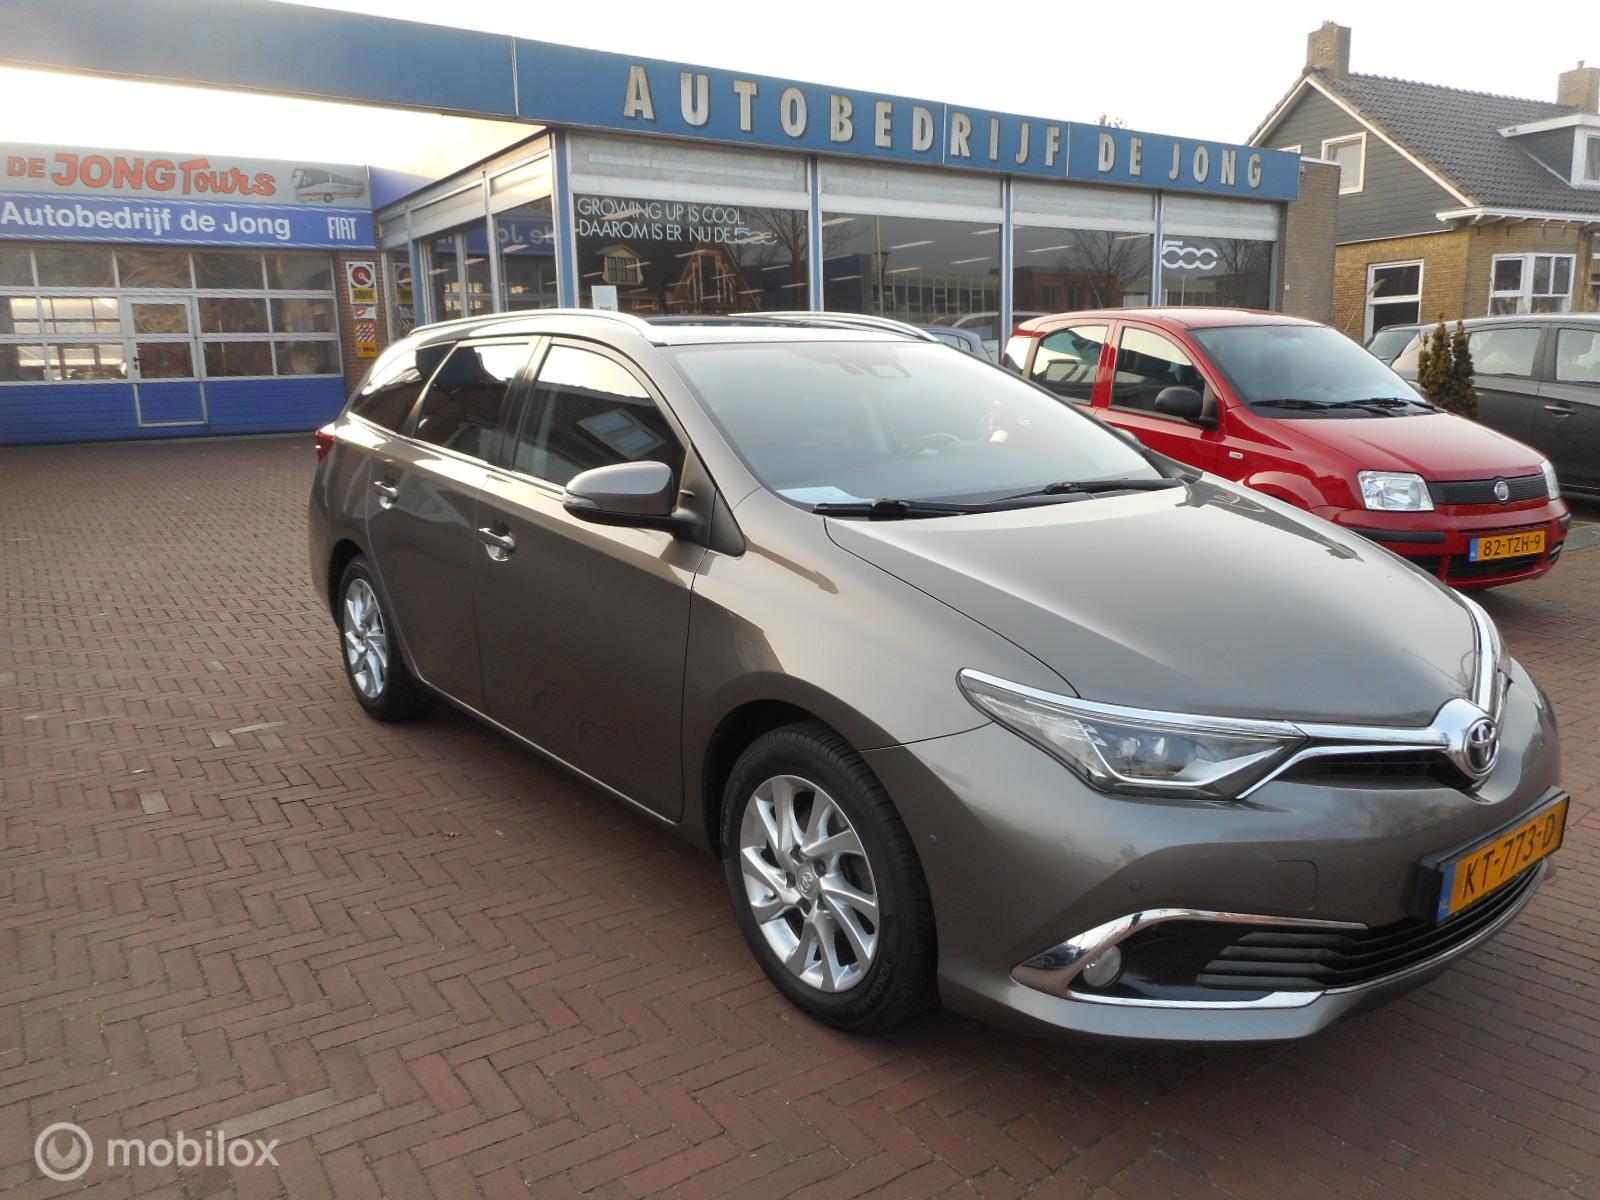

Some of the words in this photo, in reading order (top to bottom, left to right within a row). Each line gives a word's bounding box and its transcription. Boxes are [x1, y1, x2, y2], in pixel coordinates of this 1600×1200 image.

[623, 65, 1062, 169] AUTOBEDRIJF
[1097, 133, 1142, 176] DE
[1168, 142, 1262, 189] JONG
[7, 156, 48, 179] DE
[51, 152, 176, 192] JONG
[179, 158, 277, 196] Tours
[0, 201, 172, 236] Autobedrijf
[180, 209, 216, 233] de
[223, 211, 291, 240] Jong
[577, 197, 663, 220] GROWING
[666, 203, 684, 221] UP
[688, 206, 700, 223] IS
[702, 206, 745, 225] COOL.
[327, 215, 357, 241] FIAT
[579, 219, 649, 240] DAAROM
[651, 223, 663, 241] IS
[666, 224, 682, 242] ER
[689, 226, 711, 243] NU
[715, 226, 733, 244] DE
[1161, 240, 1218, 270] 500
[1483, 534, 1541, 557] 82-TZH-9
[1462, 813, 1556, 900] KT-773-D
